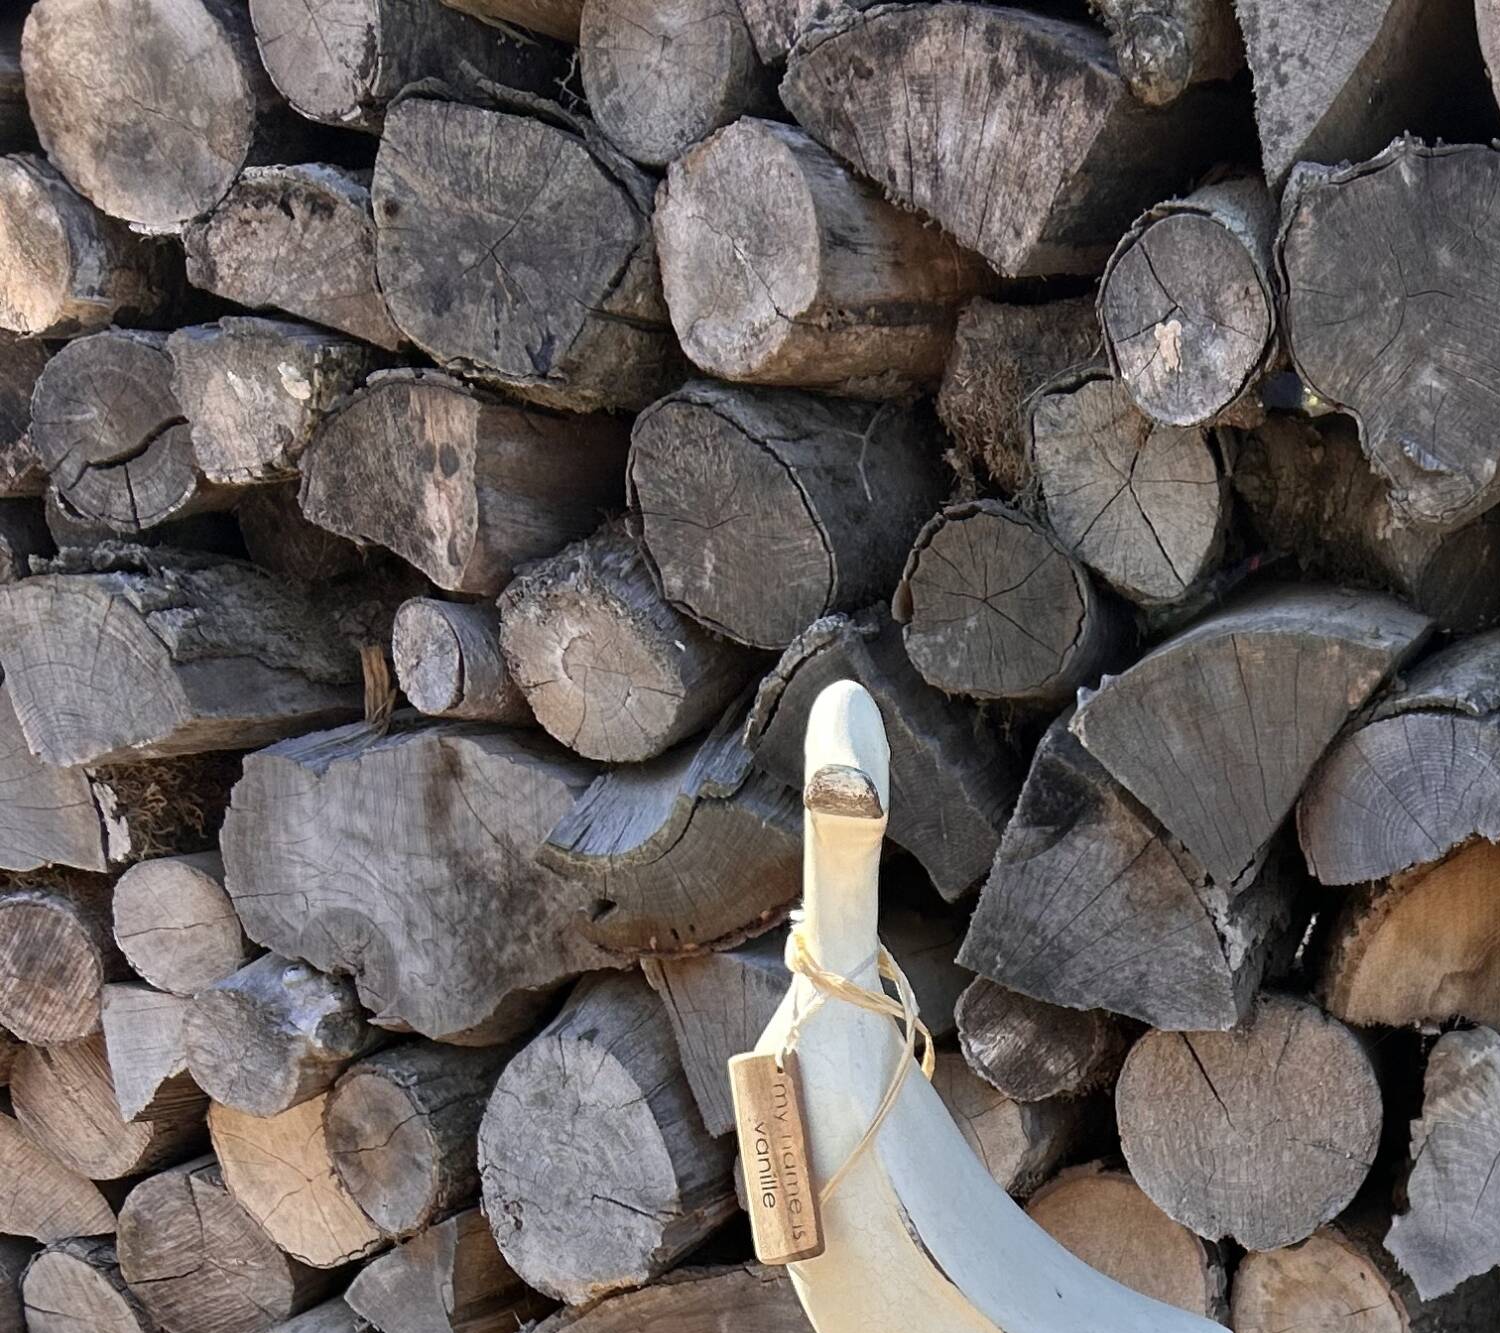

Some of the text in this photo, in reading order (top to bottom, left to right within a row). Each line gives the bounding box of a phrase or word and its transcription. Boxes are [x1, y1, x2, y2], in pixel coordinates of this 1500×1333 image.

[755, 1122, 778, 1209] vanille
[773, 1083, 806, 1240] my name is
